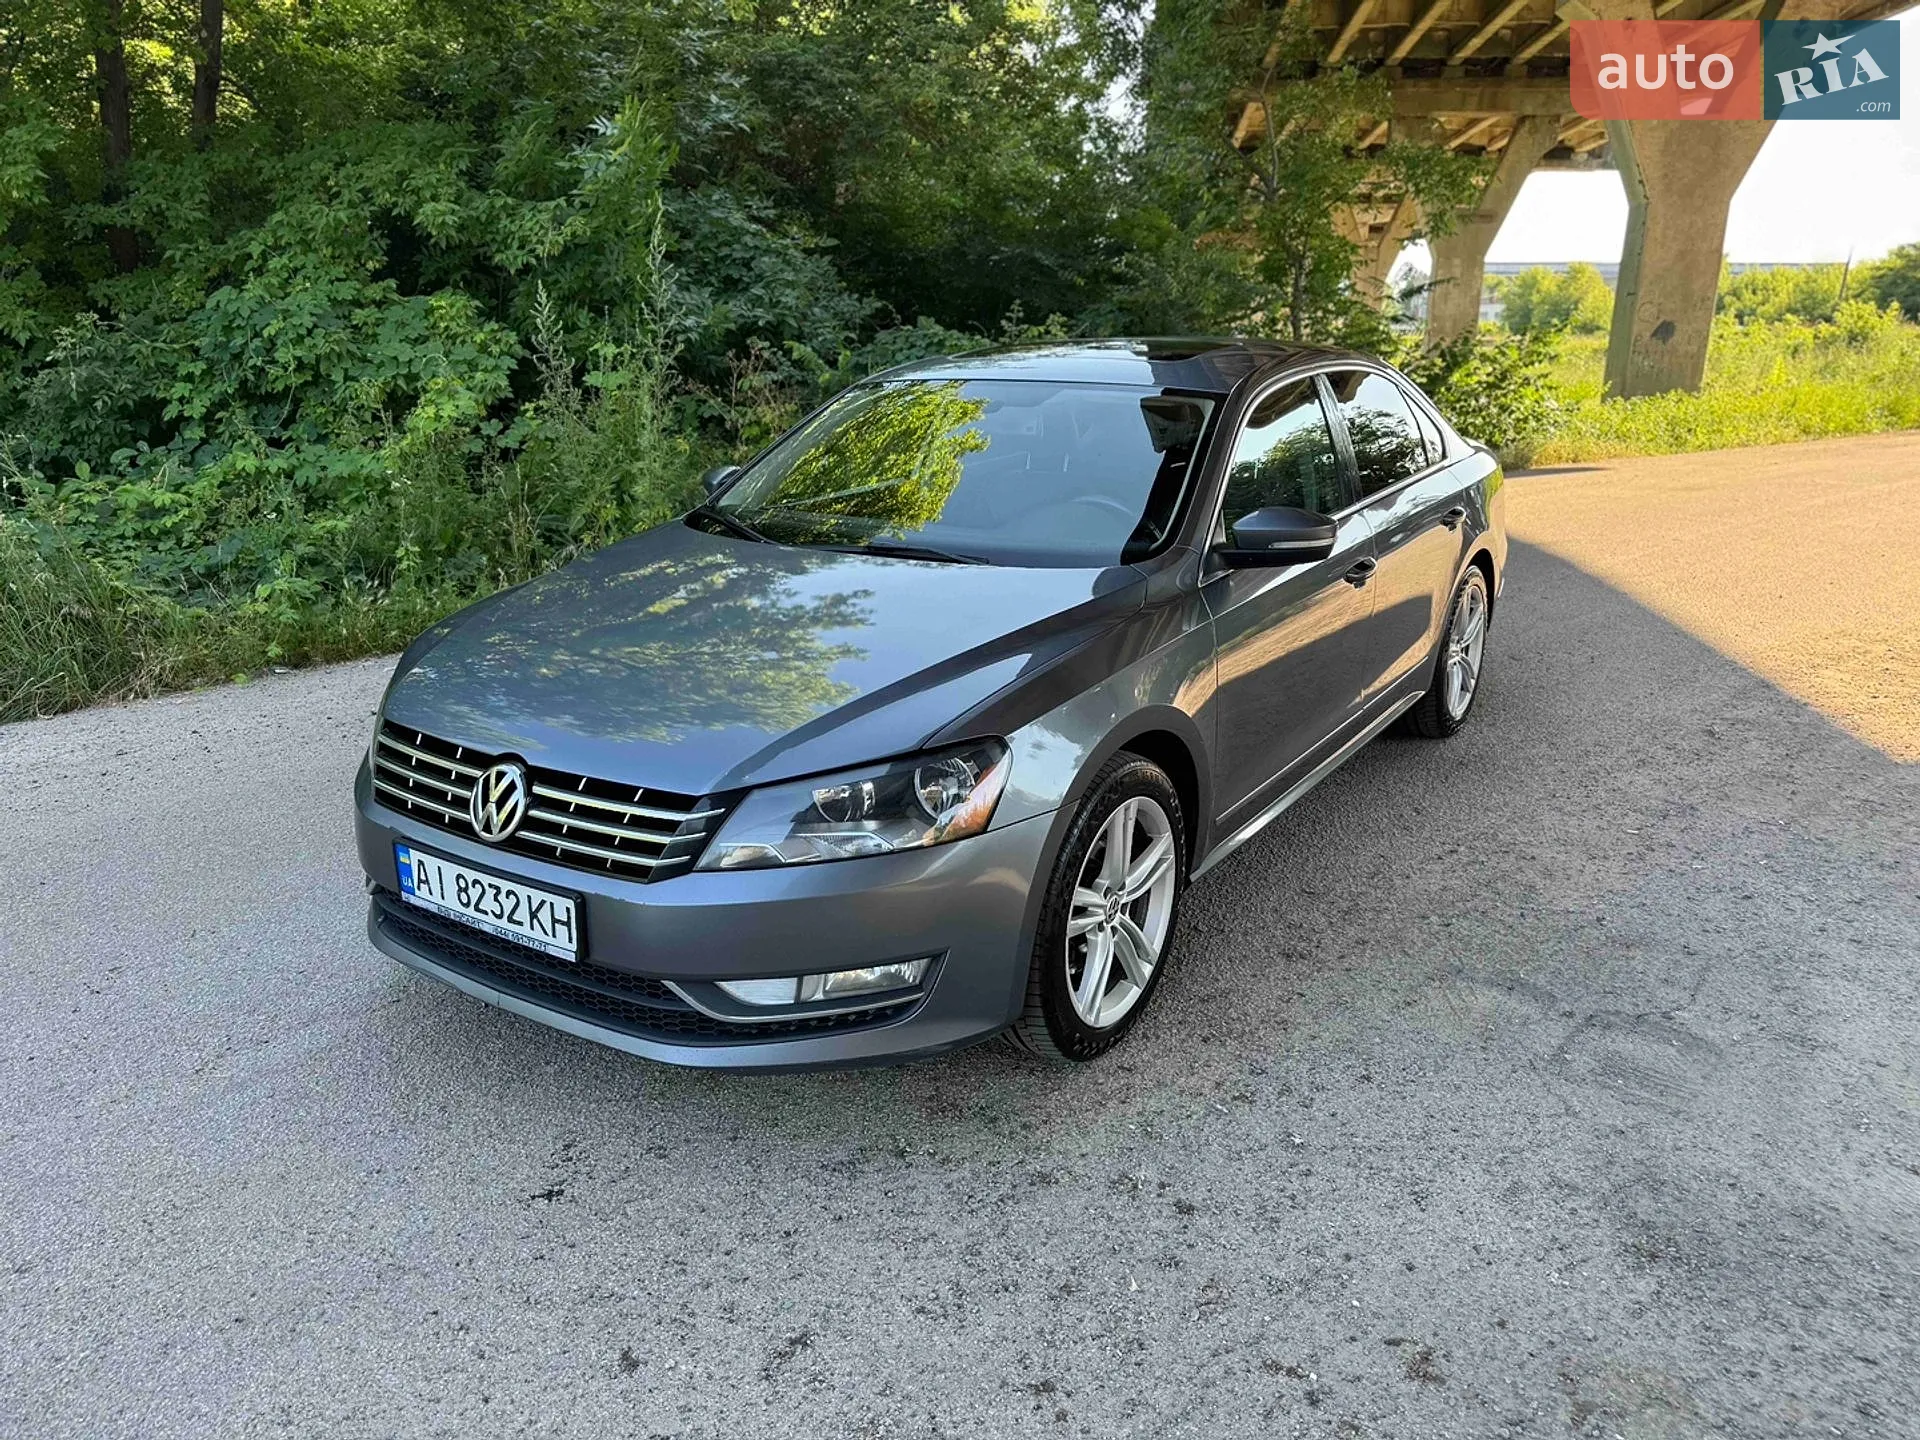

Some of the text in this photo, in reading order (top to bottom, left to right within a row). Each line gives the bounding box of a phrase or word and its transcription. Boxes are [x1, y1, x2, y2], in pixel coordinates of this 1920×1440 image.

[402, 875, 414, 888] UA
[416, 858, 445, 901] AI
[455, 873, 573, 944] 8232KH
